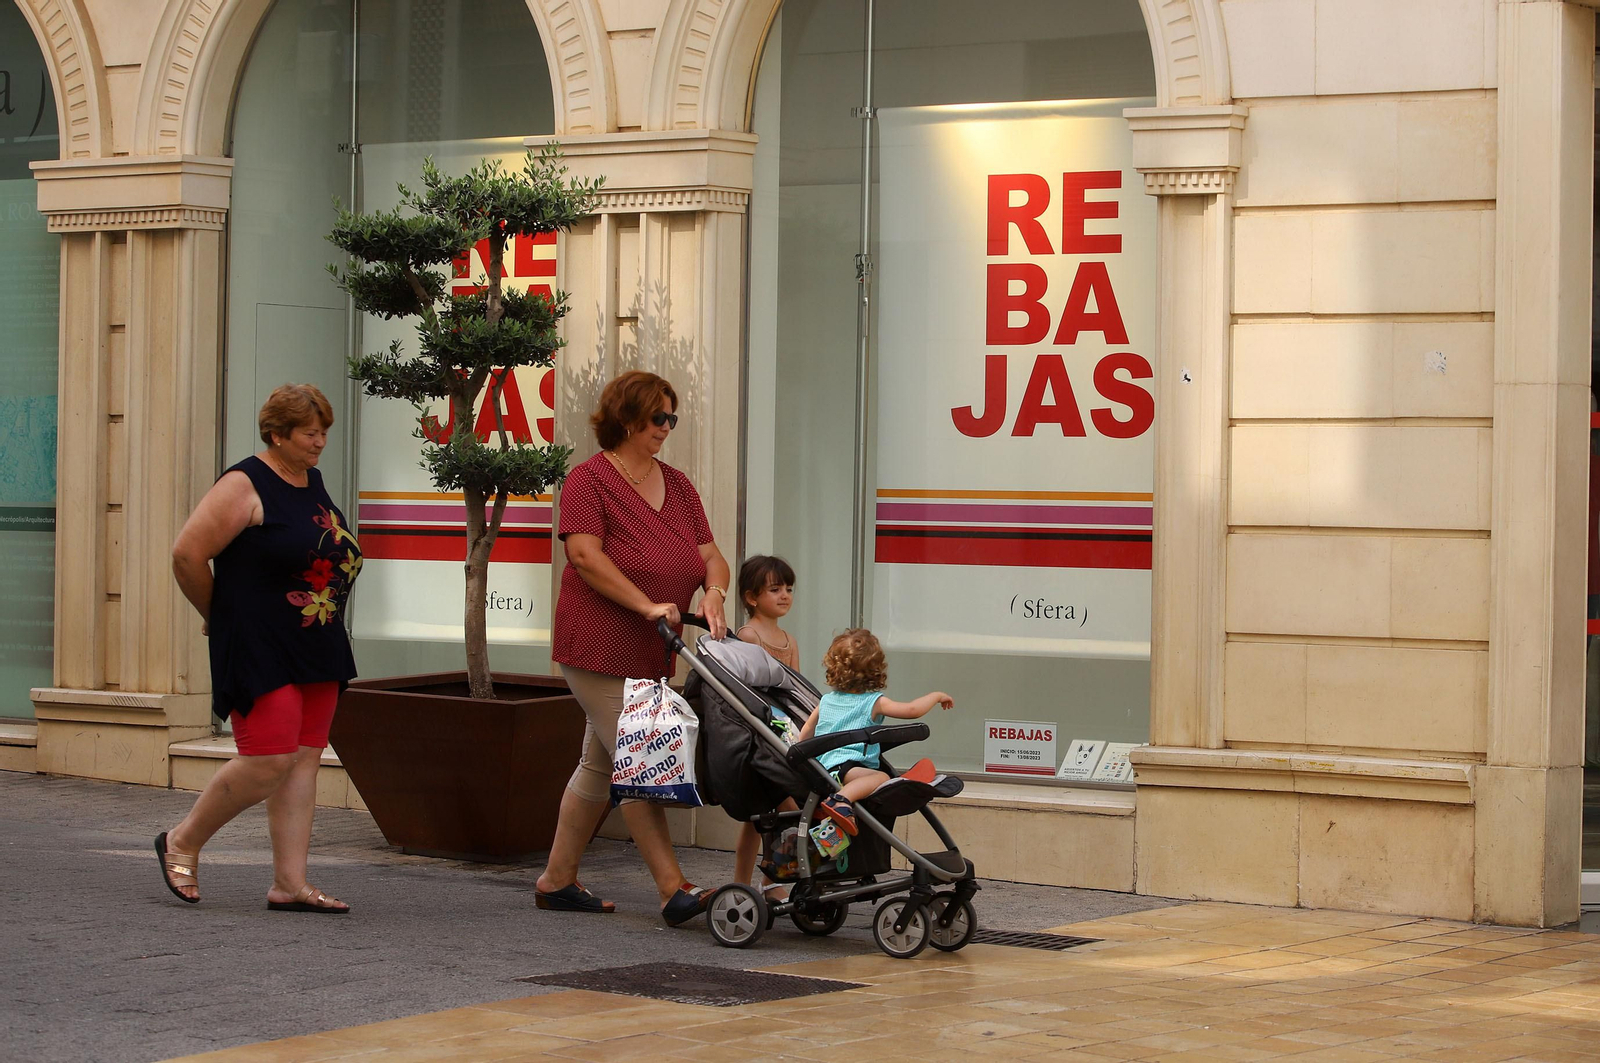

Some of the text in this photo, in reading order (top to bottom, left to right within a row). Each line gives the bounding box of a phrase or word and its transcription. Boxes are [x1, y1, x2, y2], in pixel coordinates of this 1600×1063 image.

[987, 171, 1122, 256] RE
[986, 261, 1130, 345] BA
[951, 352, 1155, 438] JAS
[630, 754, 677, 786] MADRID
[989, 726, 1053, 742] REBAJAS
